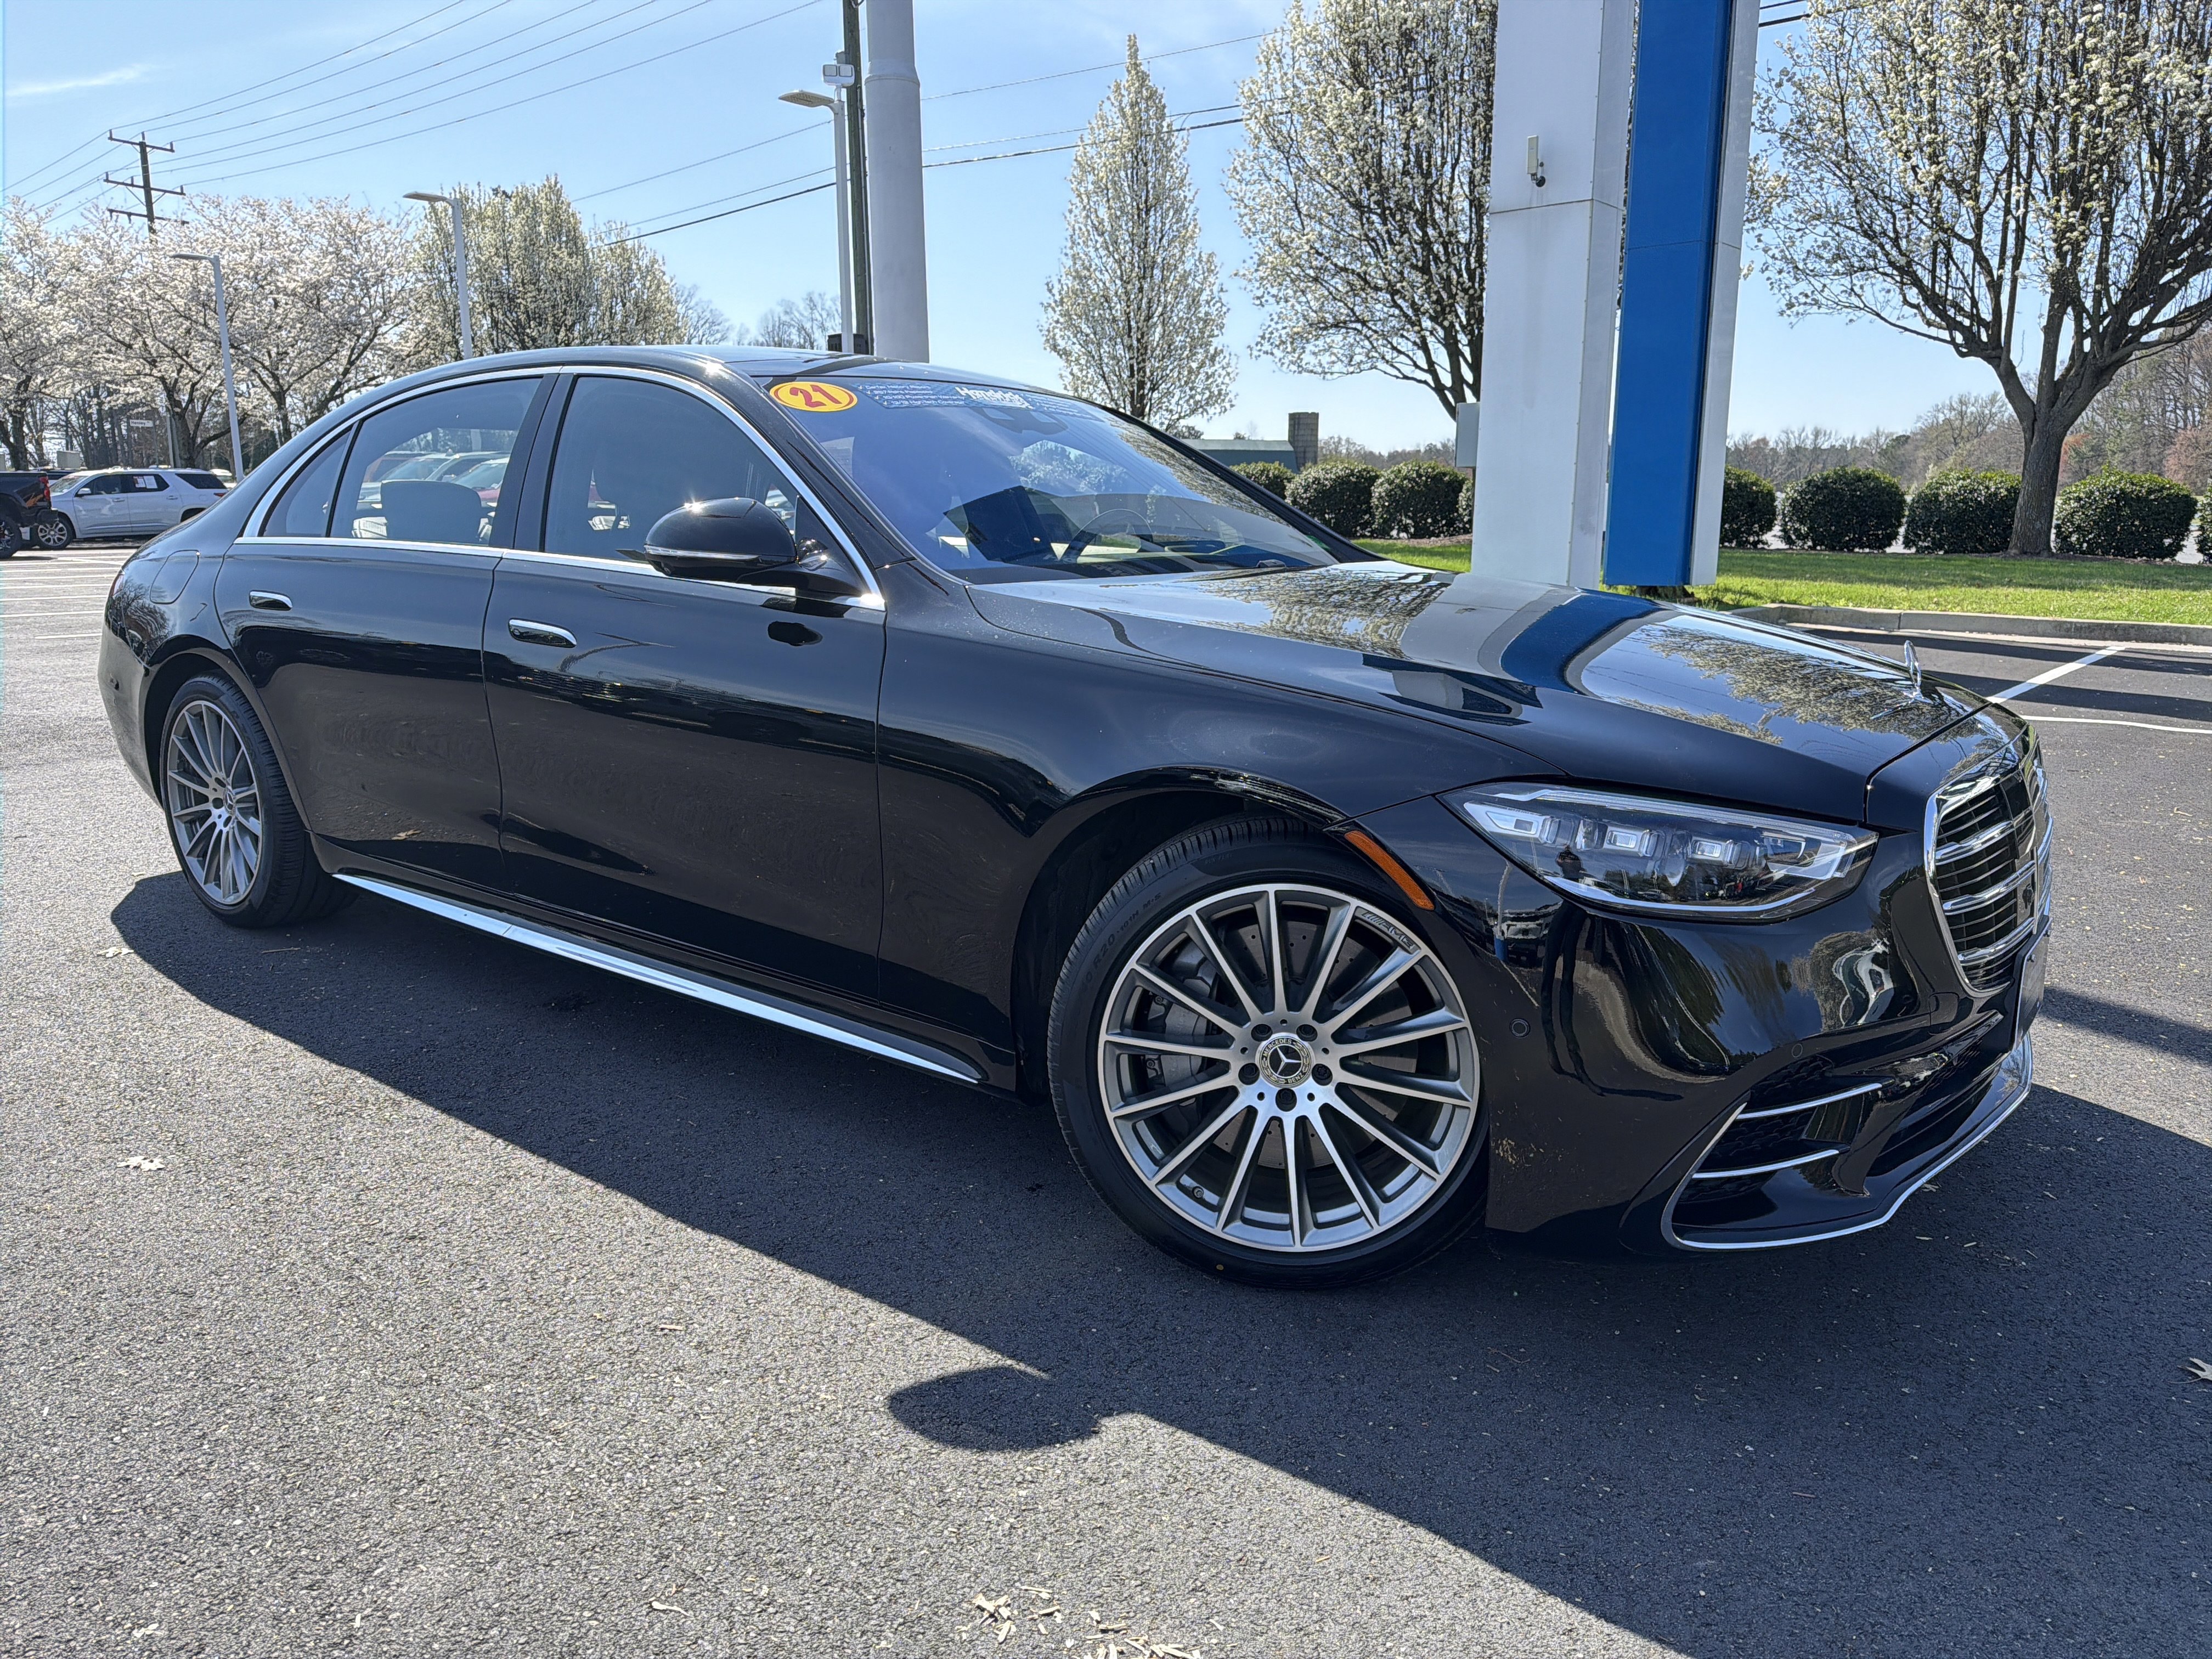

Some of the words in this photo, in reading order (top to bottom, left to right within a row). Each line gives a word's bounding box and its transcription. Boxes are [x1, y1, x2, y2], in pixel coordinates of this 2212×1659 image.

[789, 384, 843, 408] 21
[1379, 920, 1414, 949] AMG
[1262, 1039, 1292, 1057] MERCEDES
[1287, 1073, 1304, 1084] BENZ
